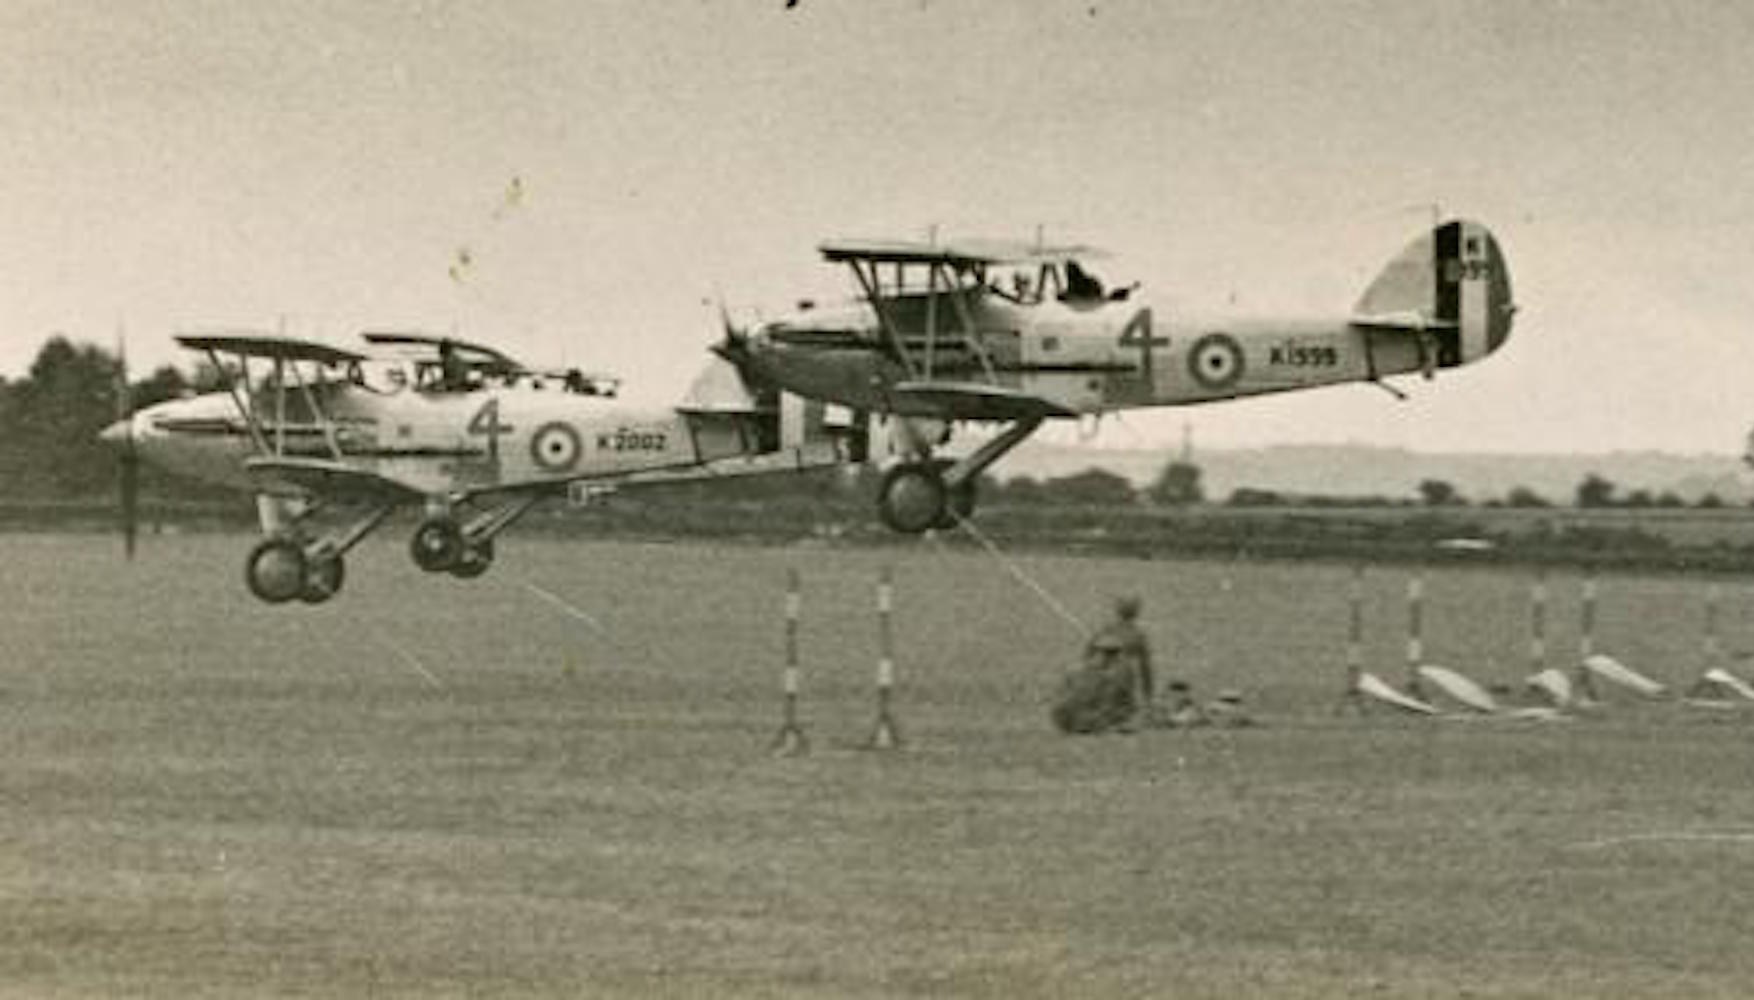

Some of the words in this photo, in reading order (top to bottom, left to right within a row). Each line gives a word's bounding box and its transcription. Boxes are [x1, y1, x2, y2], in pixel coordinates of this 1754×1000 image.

[1119, 307, 1170, 384] 4
[1270, 345, 1338, 367] K1999
[467, 398, 513, 468] 4
[598, 432, 665, 451] K2002
